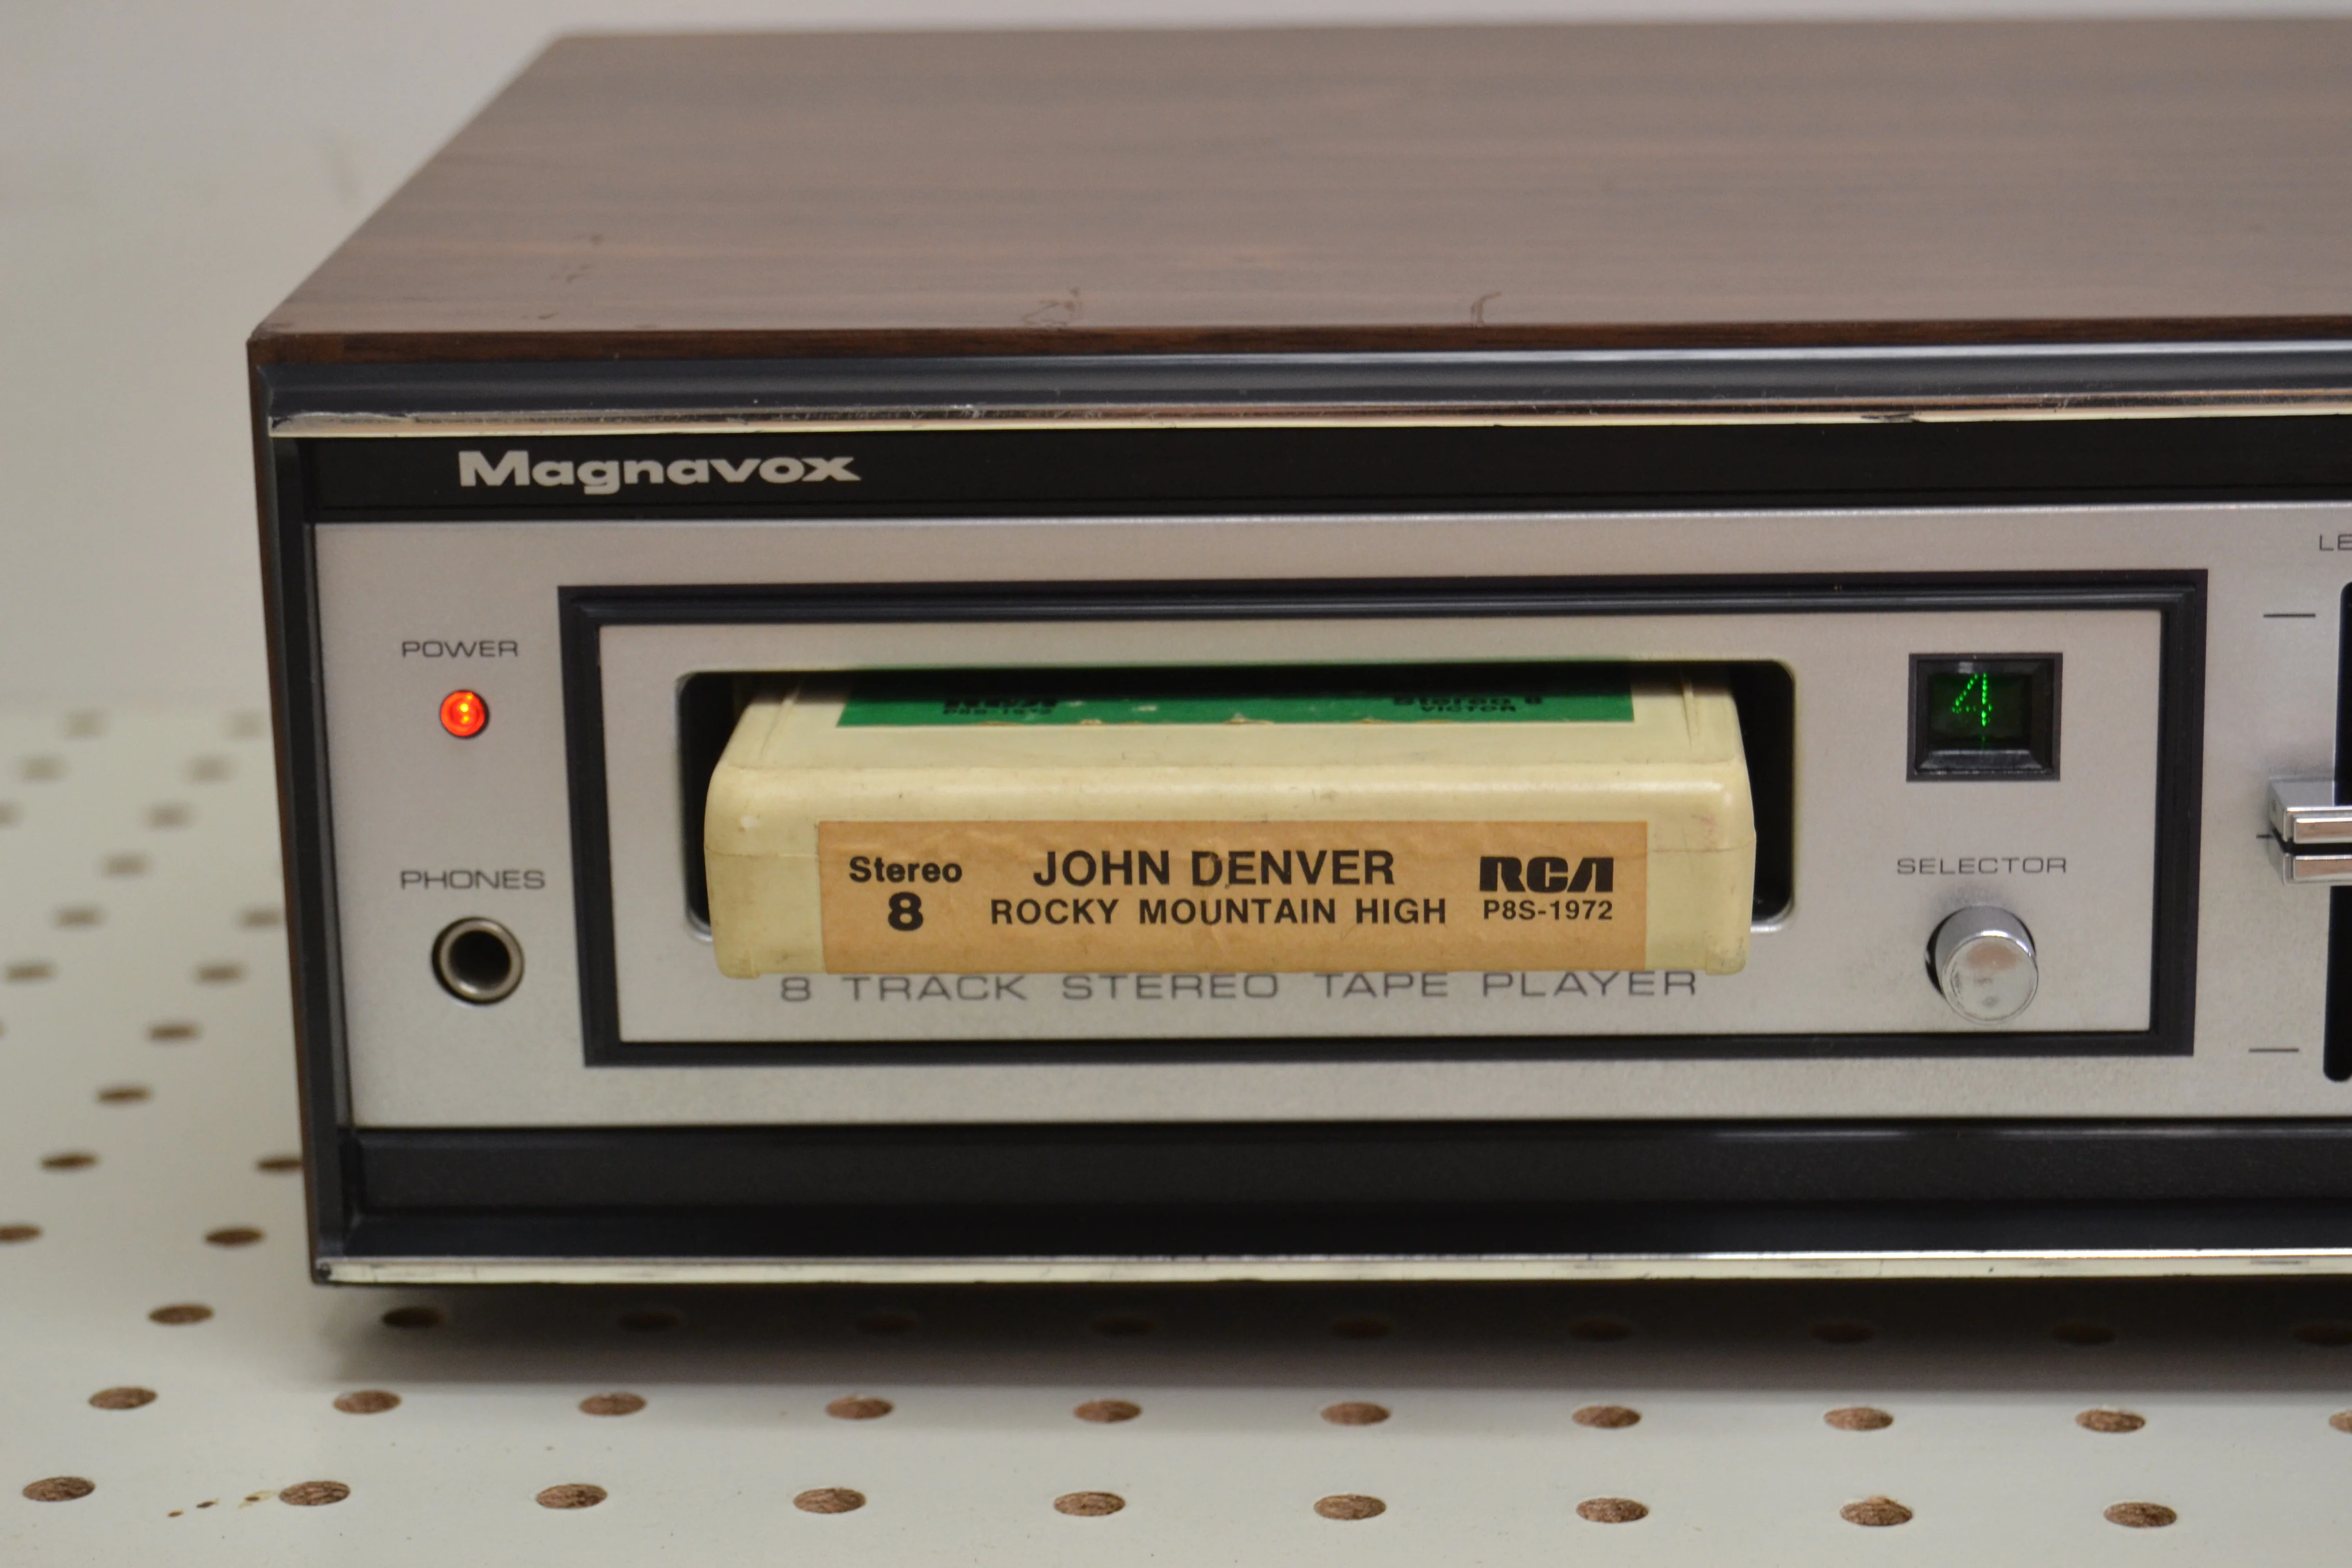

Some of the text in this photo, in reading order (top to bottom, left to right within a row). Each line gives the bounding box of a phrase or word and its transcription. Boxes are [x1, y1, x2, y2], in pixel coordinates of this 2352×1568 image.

[458, 450, 861, 495] Magnavox
[401, 640, 519, 658] POWER
[1951, 672, 1992, 727] 4
[400, 869, 546, 890] PHONES
[848, 855, 963, 884] Stereo
[1033, 849, 1395, 887] JOHN DENVER
[1479, 855, 1614, 893] RCA
[1896, 856, 2067, 876] SELECTOR
[887, 891, 924, 932] 8
[990, 897, 1446, 926] ROCKY MOUNTAIN HIGH
[1483, 899, 1613, 921] P8S-1972
[780, 971, 1696, 1003] 8 TRACK STEREO TAPE PLAYER
